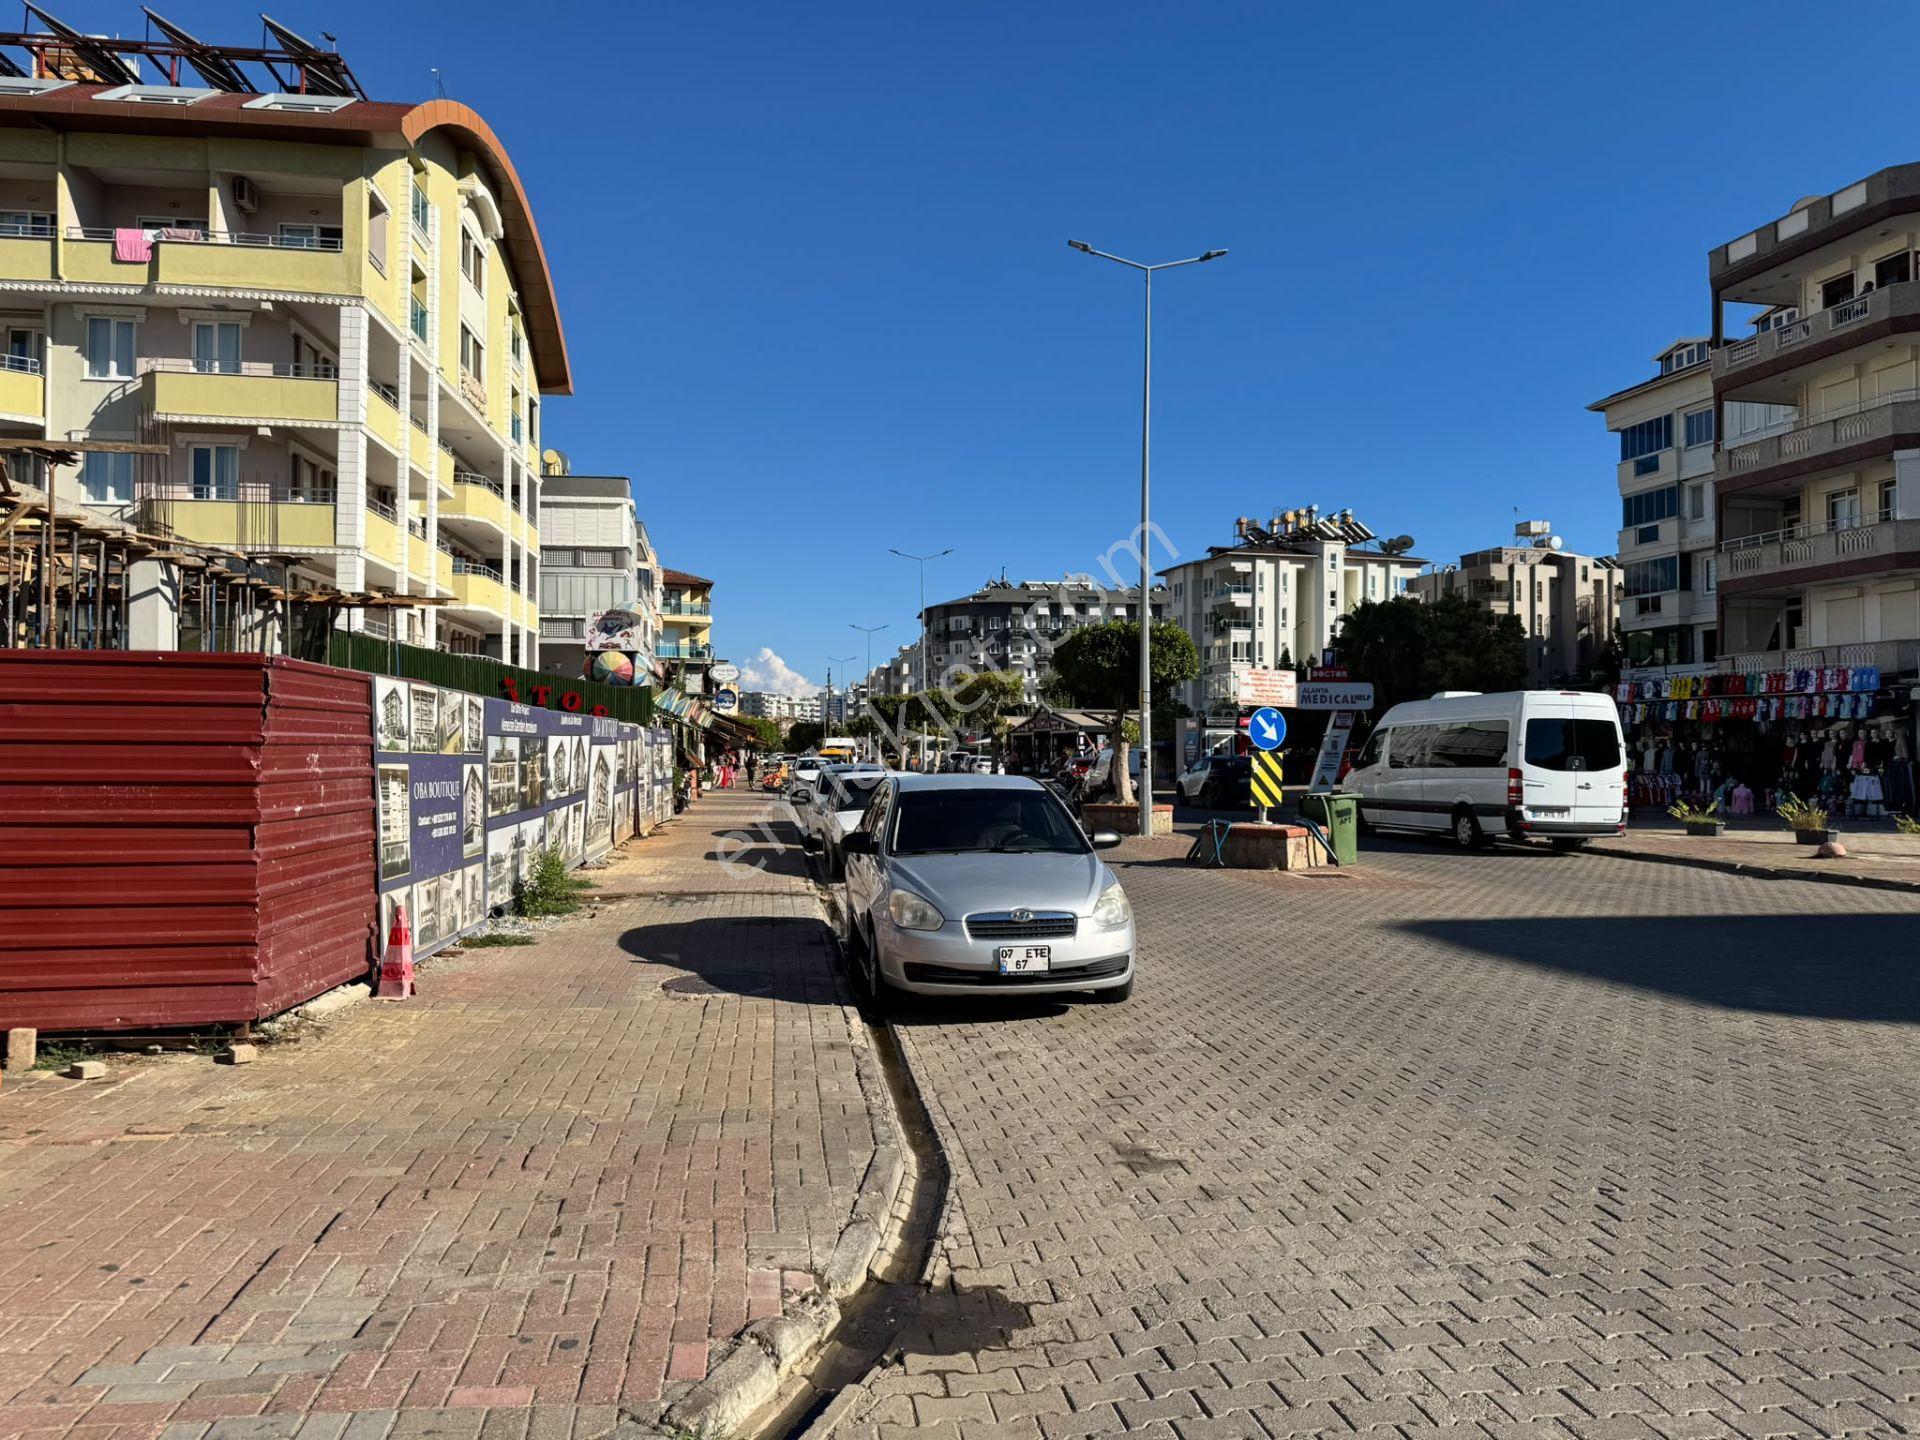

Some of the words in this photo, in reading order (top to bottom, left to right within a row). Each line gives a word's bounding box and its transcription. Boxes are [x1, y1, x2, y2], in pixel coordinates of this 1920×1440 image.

[1312, 670, 1348, 678] DOCTOR
[1301, 694, 1356, 705] MEDICAL
[413, 781, 428, 800] OBA
[429, 780, 460, 800] BOUTIQUE
[1001, 949, 1013, 959] 07
[1026, 948, 1047, 958] ETE
[1015, 960, 1028, 970] 67
